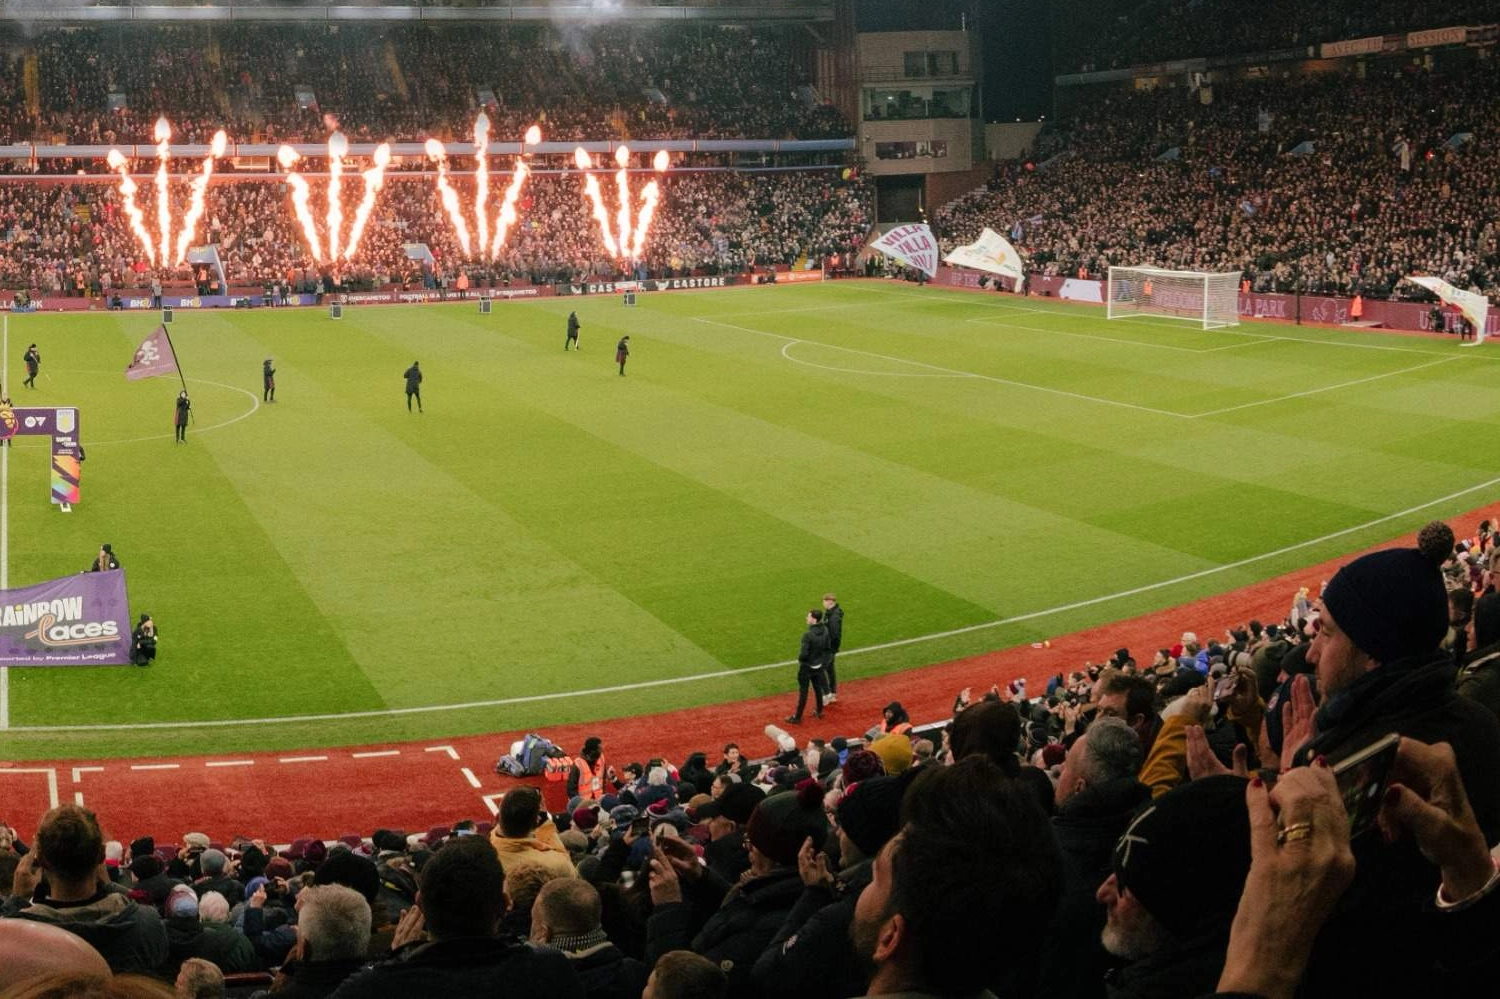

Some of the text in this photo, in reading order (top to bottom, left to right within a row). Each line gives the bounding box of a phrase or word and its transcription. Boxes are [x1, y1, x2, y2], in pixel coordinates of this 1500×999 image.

[882, 224, 924, 246] VILLA
[895, 235, 933, 255] VILLA
[673, 277, 726, 289] CASTORE
[1255, 299, 1286, 316] PARK
[82, 652, 116, 660] League
